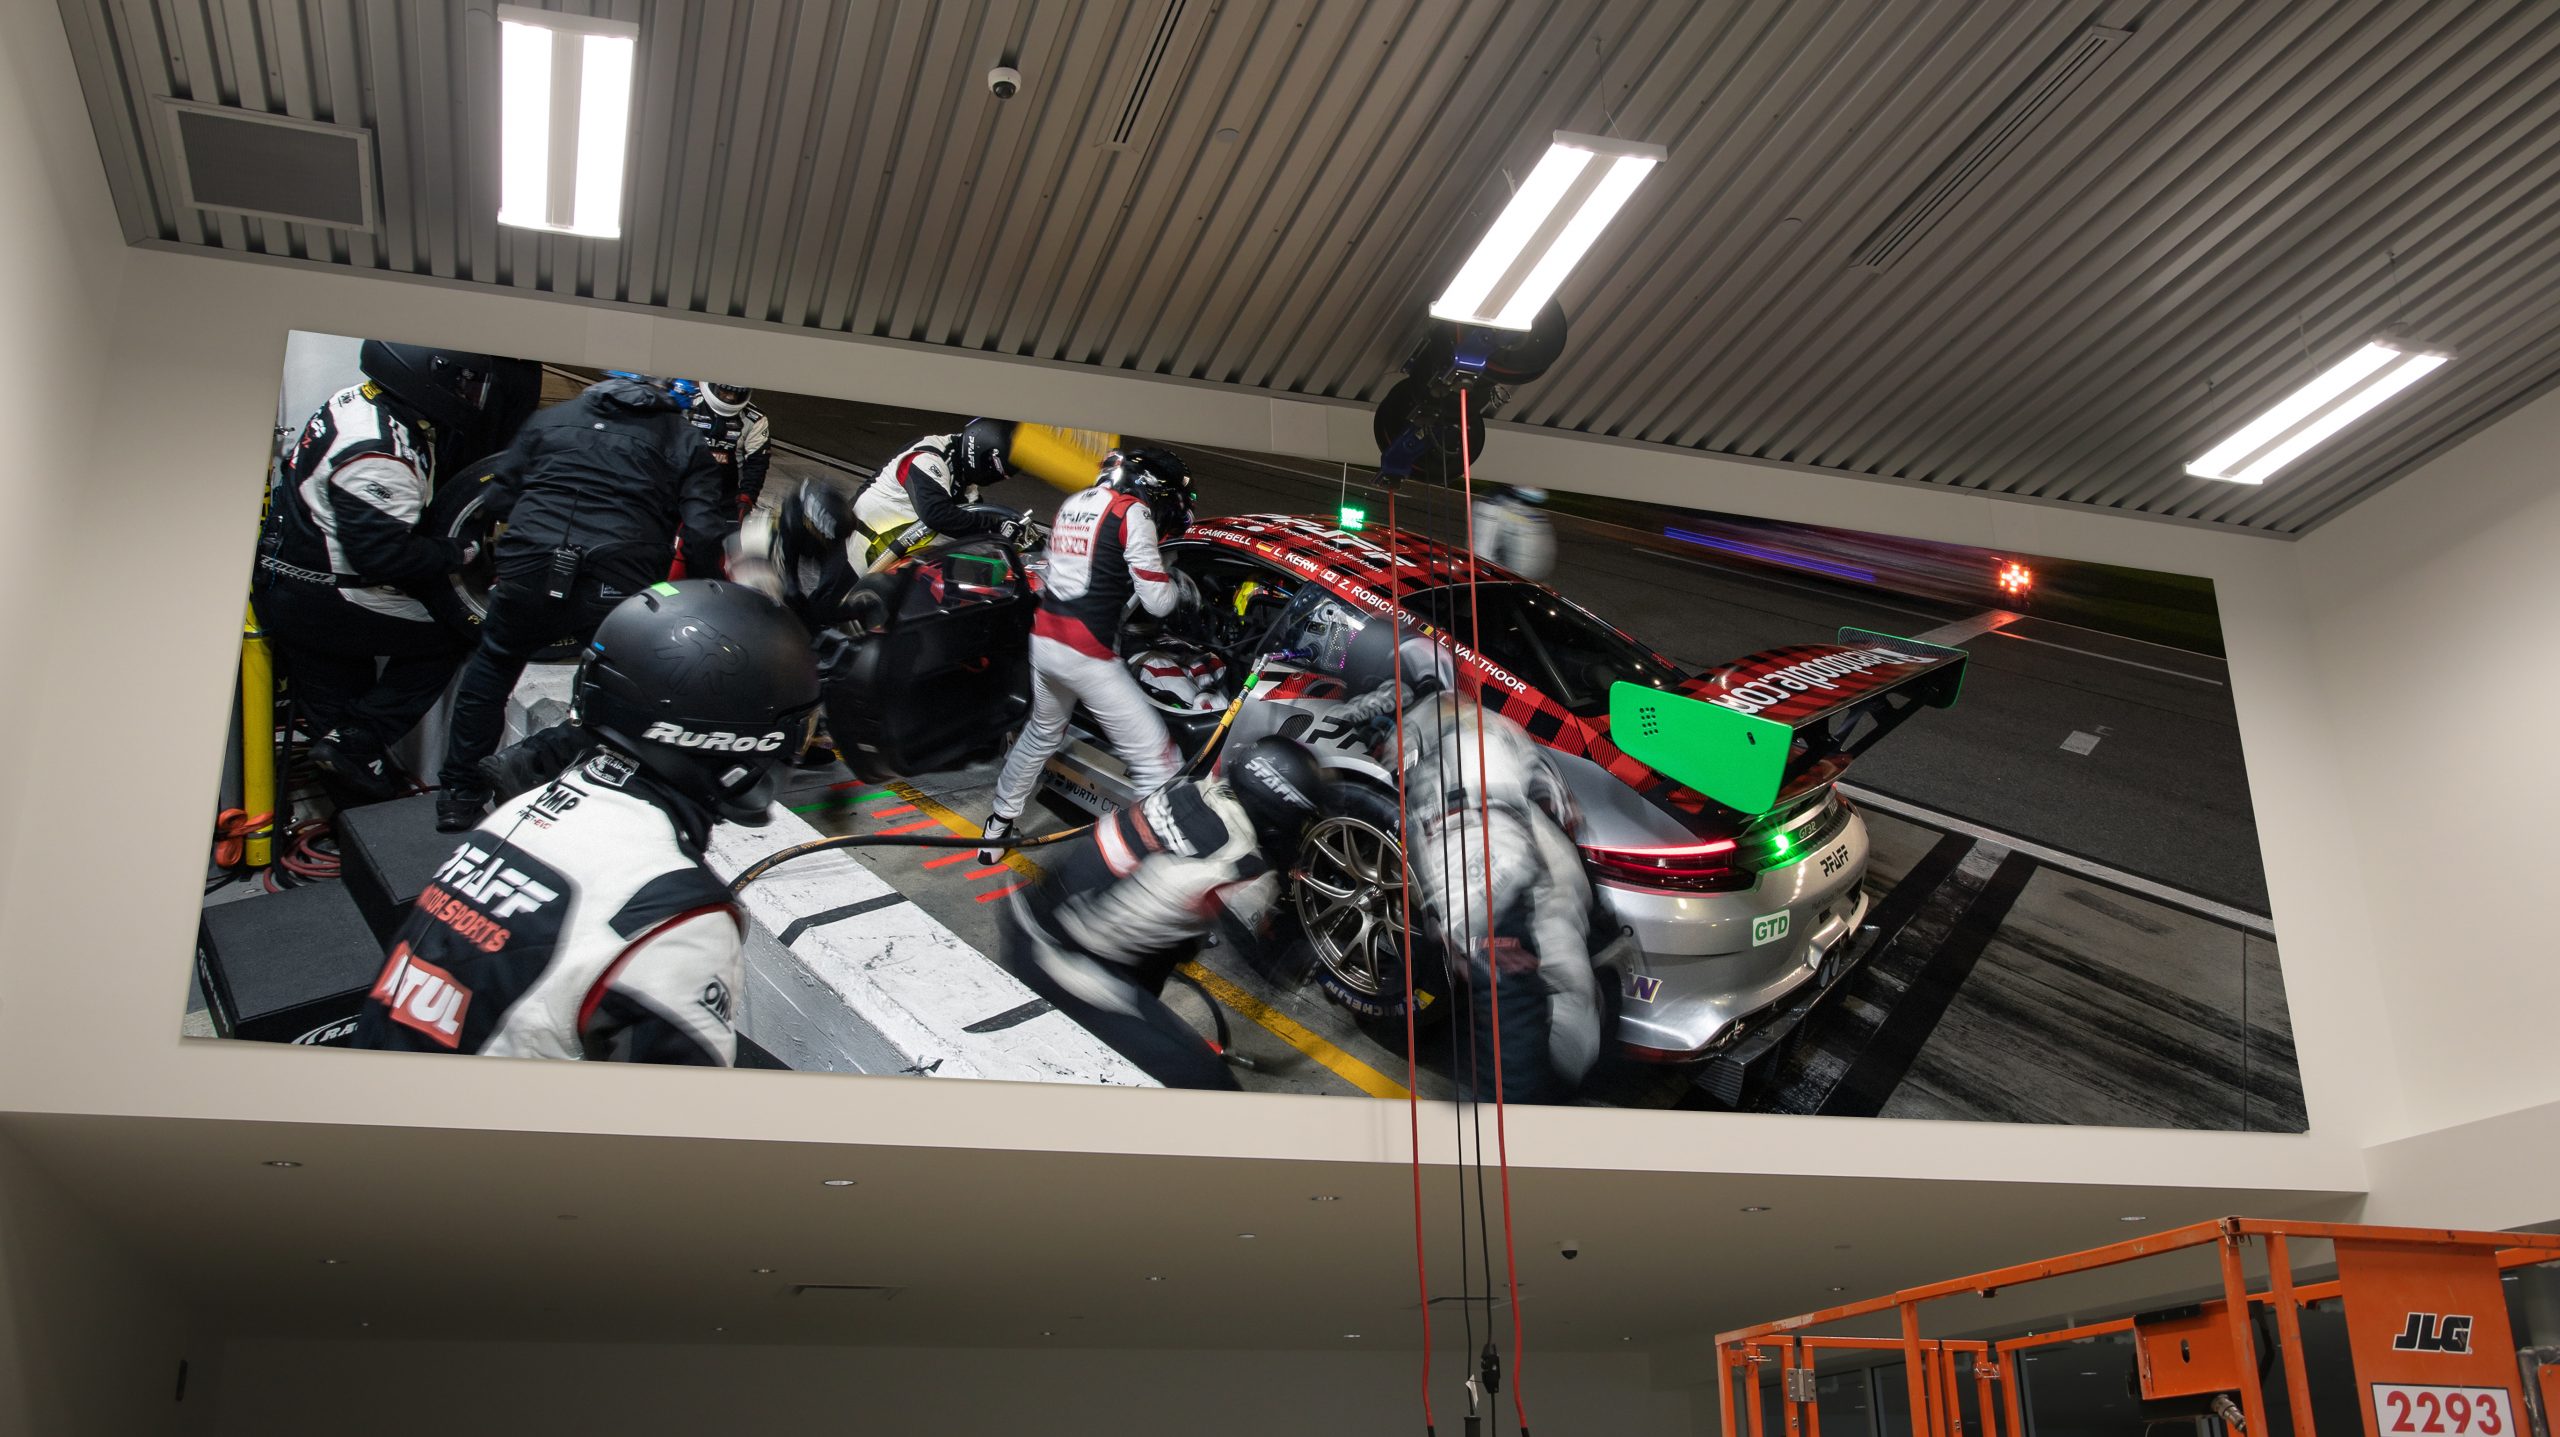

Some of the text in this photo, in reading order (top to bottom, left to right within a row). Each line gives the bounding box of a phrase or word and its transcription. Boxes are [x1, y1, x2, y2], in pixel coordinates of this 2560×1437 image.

[1198, 527, 1252, 546] CAMPBELL
[1273, 546, 1283, 559] L.
[1285, 552, 1320, 574] KERN
[1338, 578, 1349, 591] Z.
[1439, 635, 1450, 649] L.
[1820, 844, 1849, 877] PFAFF
[1755, 915, 1788, 941] GTD
[2394, 1313, 2472, 1354] JLG
[2386, 1390, 2502, 1436] 2293
